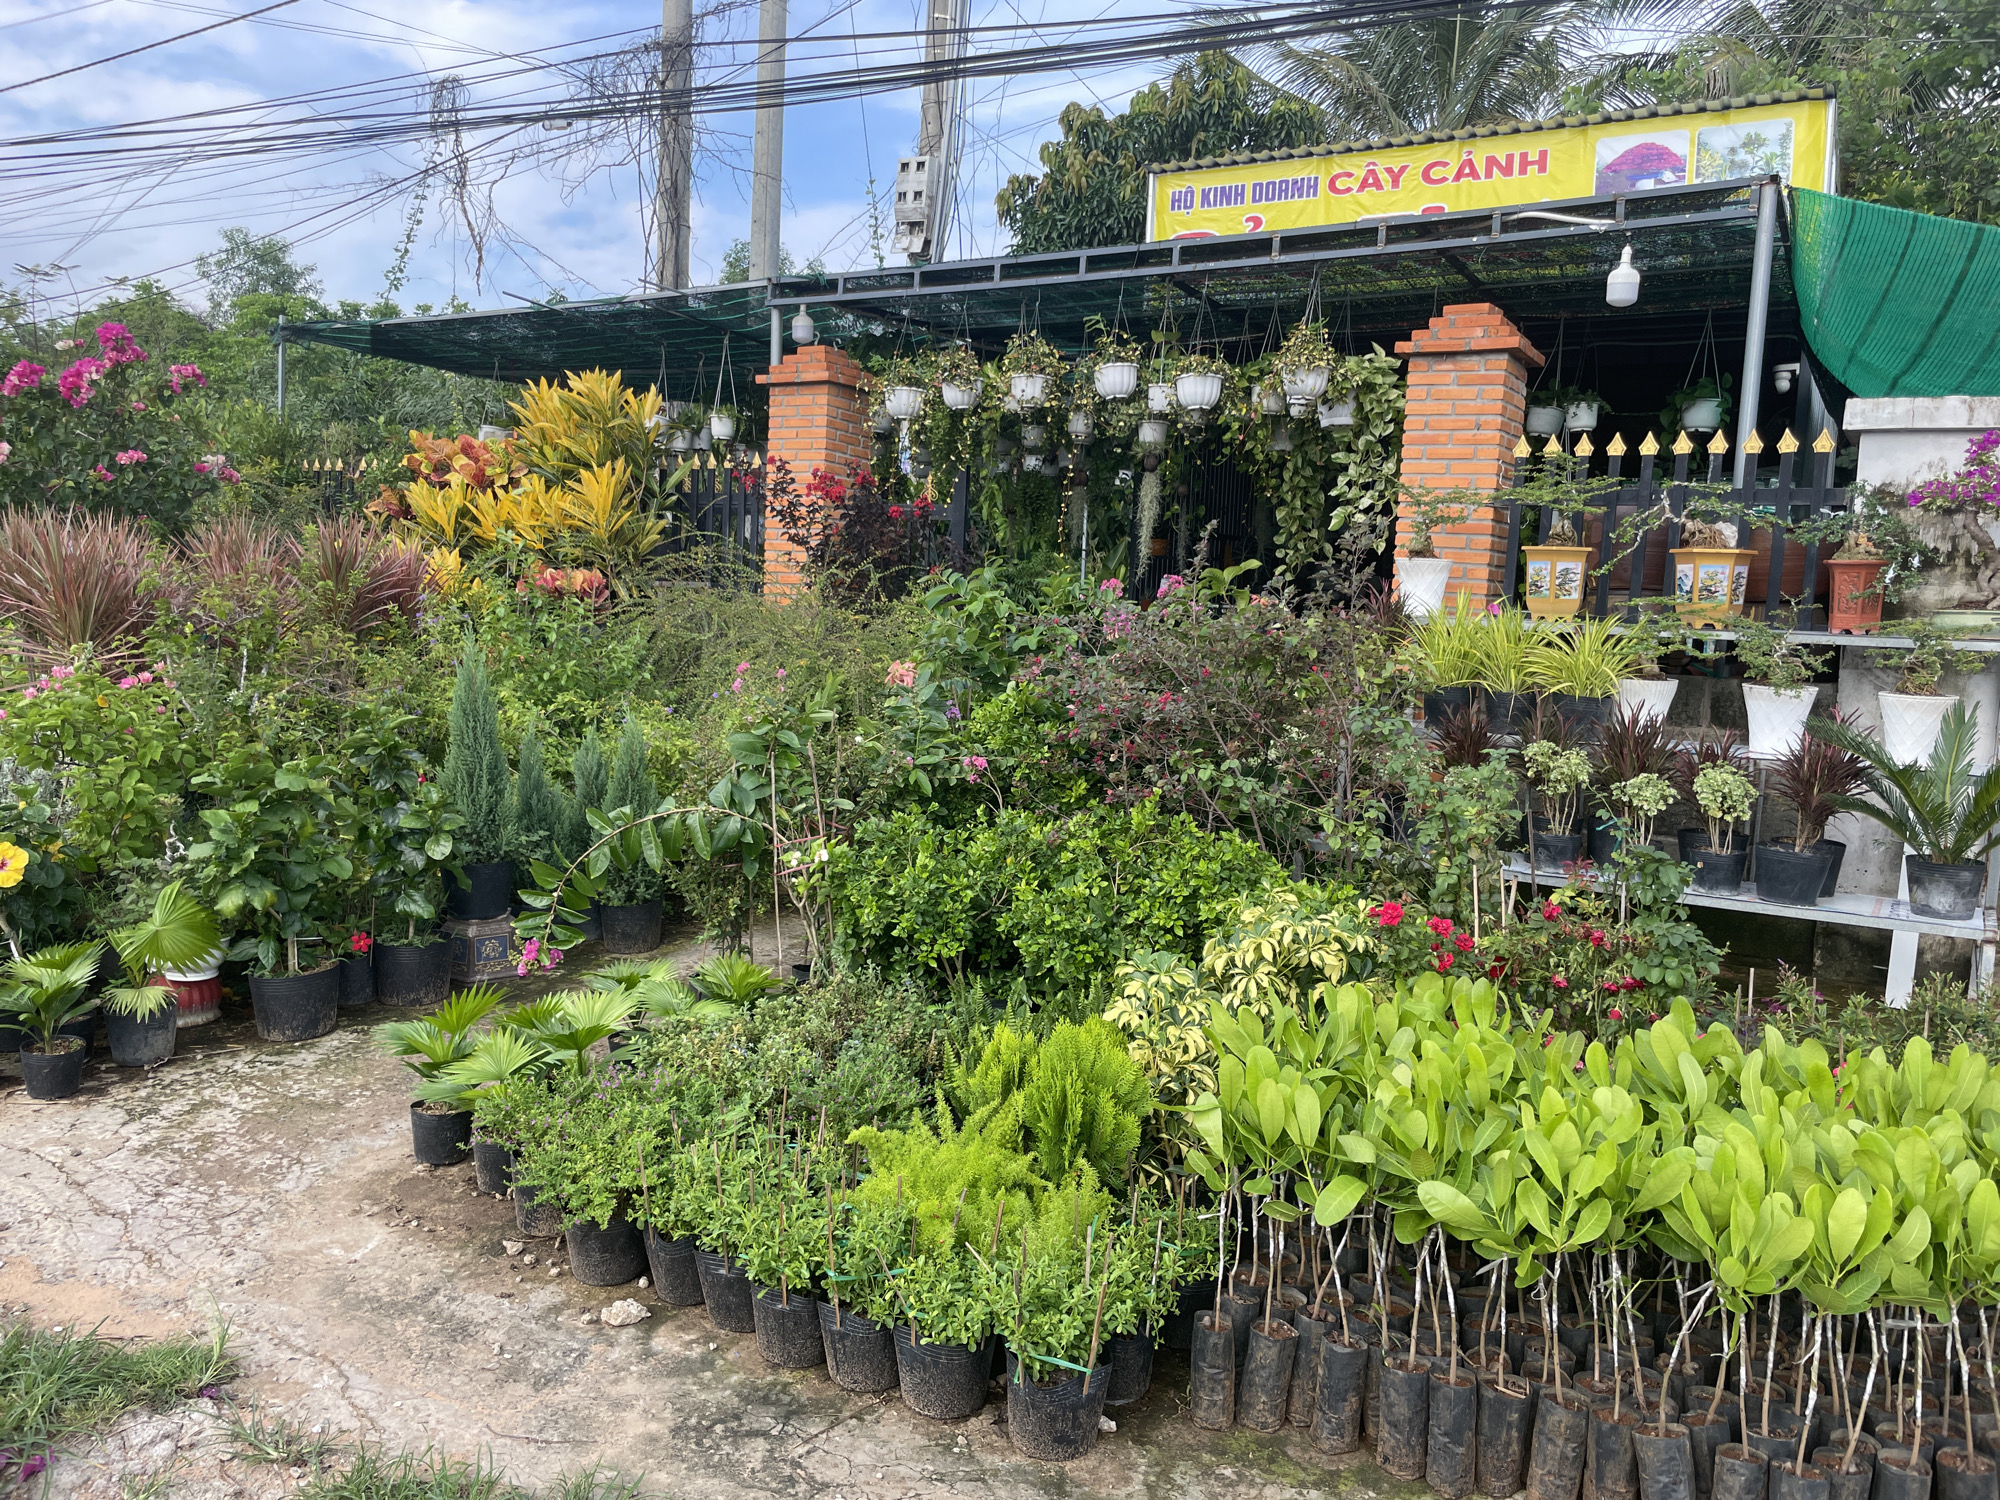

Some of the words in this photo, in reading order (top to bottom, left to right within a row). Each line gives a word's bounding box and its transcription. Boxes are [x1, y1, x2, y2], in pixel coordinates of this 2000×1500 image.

[1170, 185, 1195, 215] HỘ
[1200, 183, 1246, 209] KINH
[1251, 176, 1320, 204] DOANH
[1327, 161, 1411, 196] CÂY
[1420, 150, 1549, 186] CẢNH
